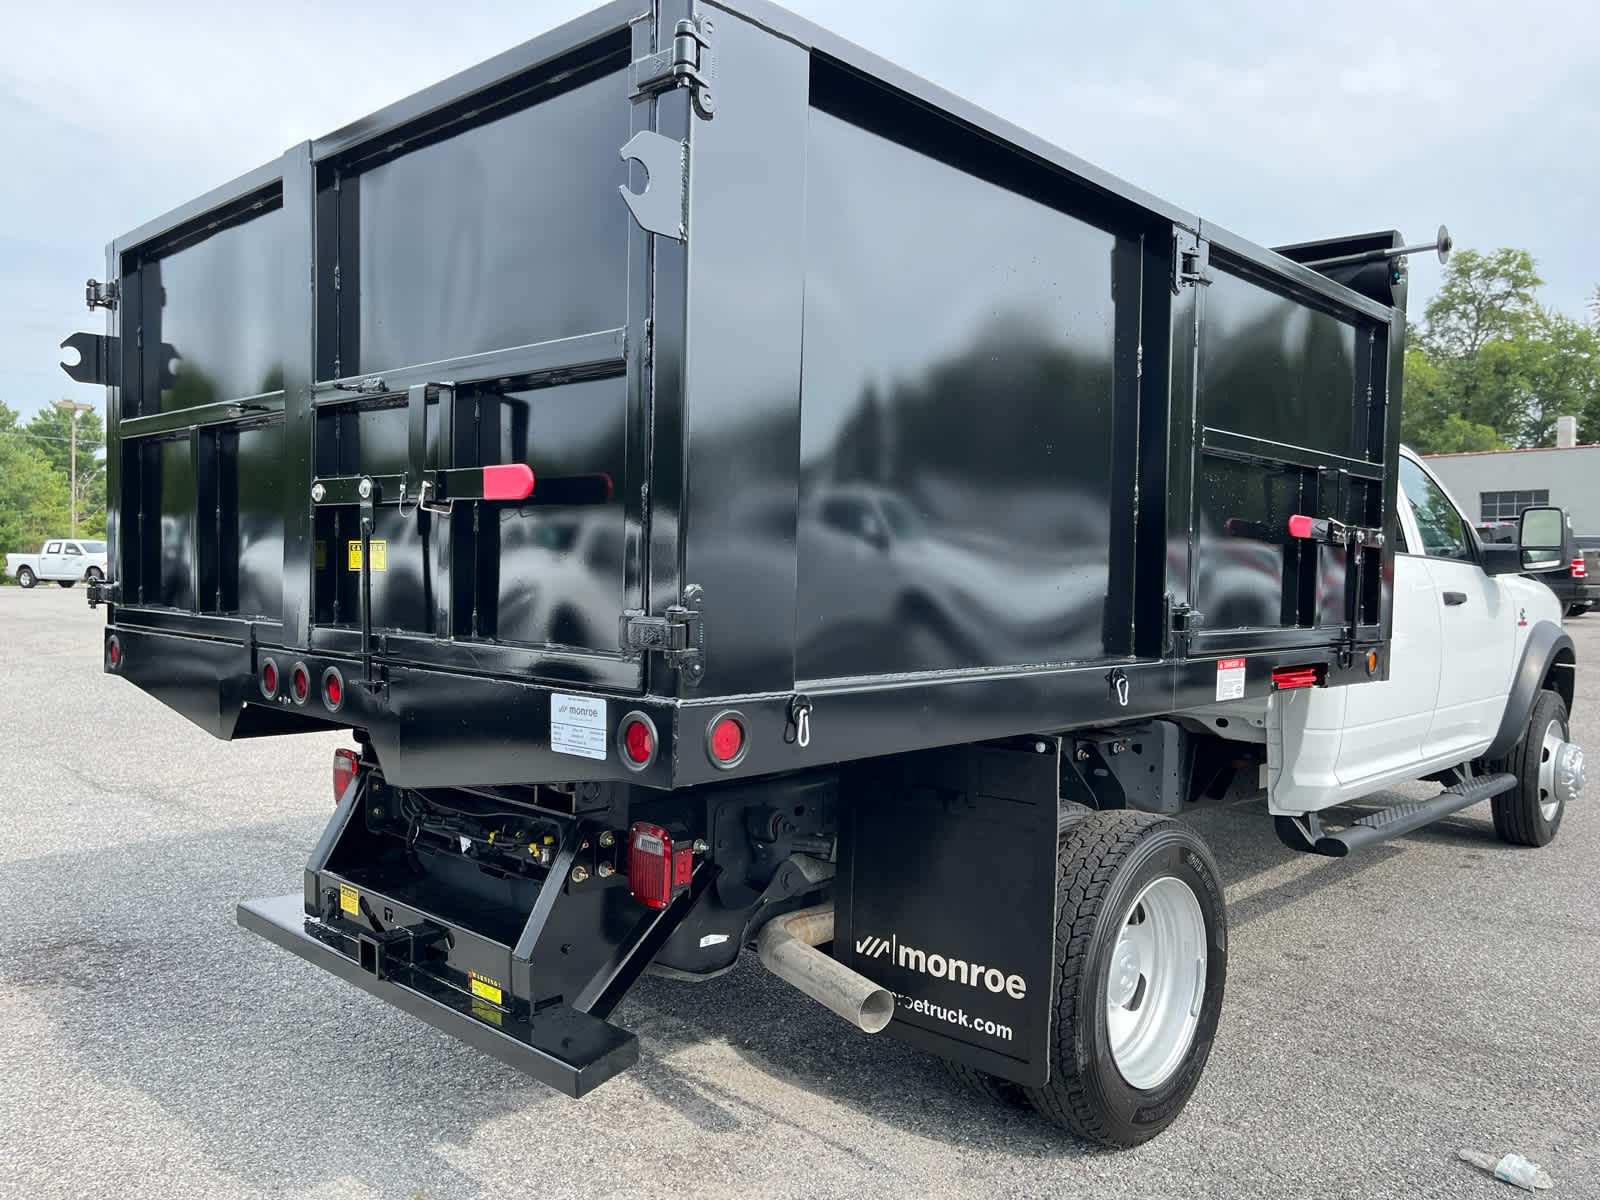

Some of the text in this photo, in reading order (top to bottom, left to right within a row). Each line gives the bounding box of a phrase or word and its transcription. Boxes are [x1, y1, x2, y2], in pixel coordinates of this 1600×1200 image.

[569, 706, 599, 718] monroe
[898, 944, 1027, 1000] monroe
[891, 991, 1013, 1041] oetruck.com
